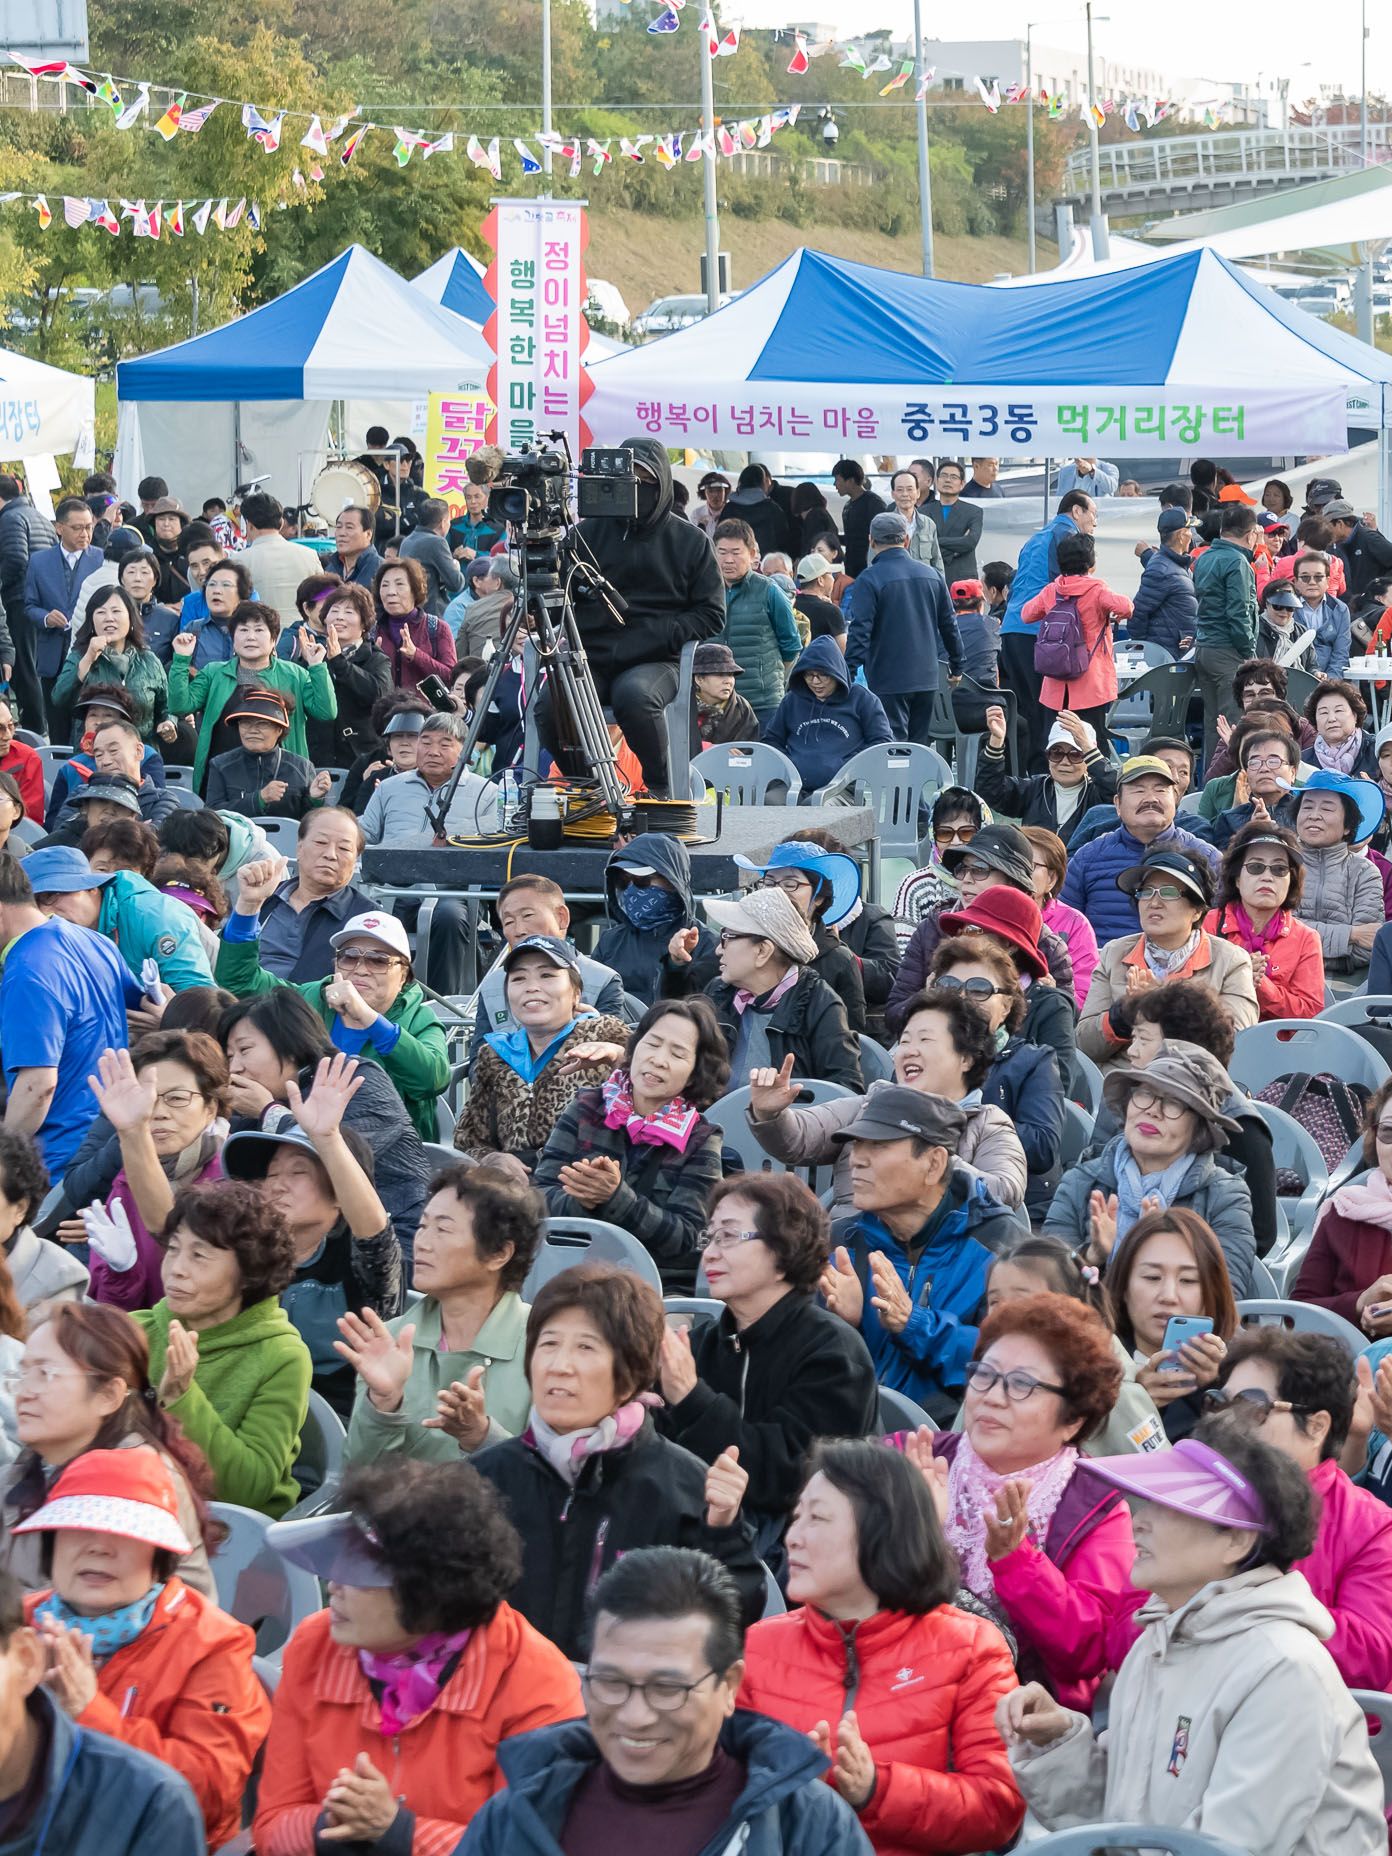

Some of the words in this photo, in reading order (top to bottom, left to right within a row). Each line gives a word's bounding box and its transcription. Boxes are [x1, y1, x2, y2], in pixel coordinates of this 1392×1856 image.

[509, 259, 536, 365] 행복한
[544, 241, 569, 416] 정이넘치는
[509, 381, 536, 448] 마을
[635, 401, 719, 434] 행복이
[730, 404, 814, 438] 넘치는
[823, 406, 880, 440] 마을
[900, 402, 1039, 443] 중곡3동
[1056, 403, 1246, 444] 먹거리장터
